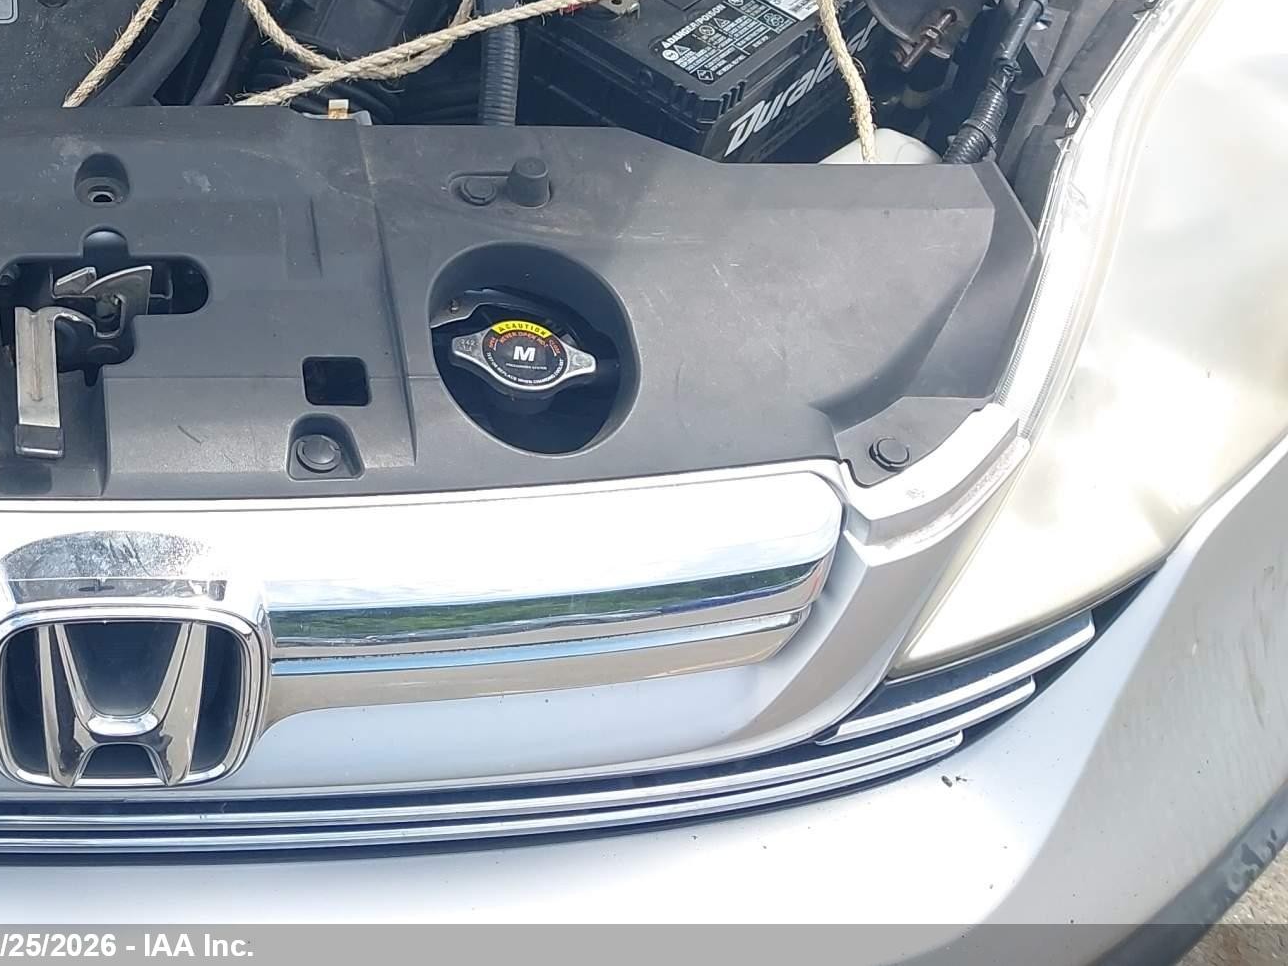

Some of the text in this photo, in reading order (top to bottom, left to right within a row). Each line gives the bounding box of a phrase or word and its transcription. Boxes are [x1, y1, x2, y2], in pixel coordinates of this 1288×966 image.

[667, 4, 727, 48] DANGER/POISON
[505, 322, 546, 336] CAUTION
[513, 345, 536, 361] M
